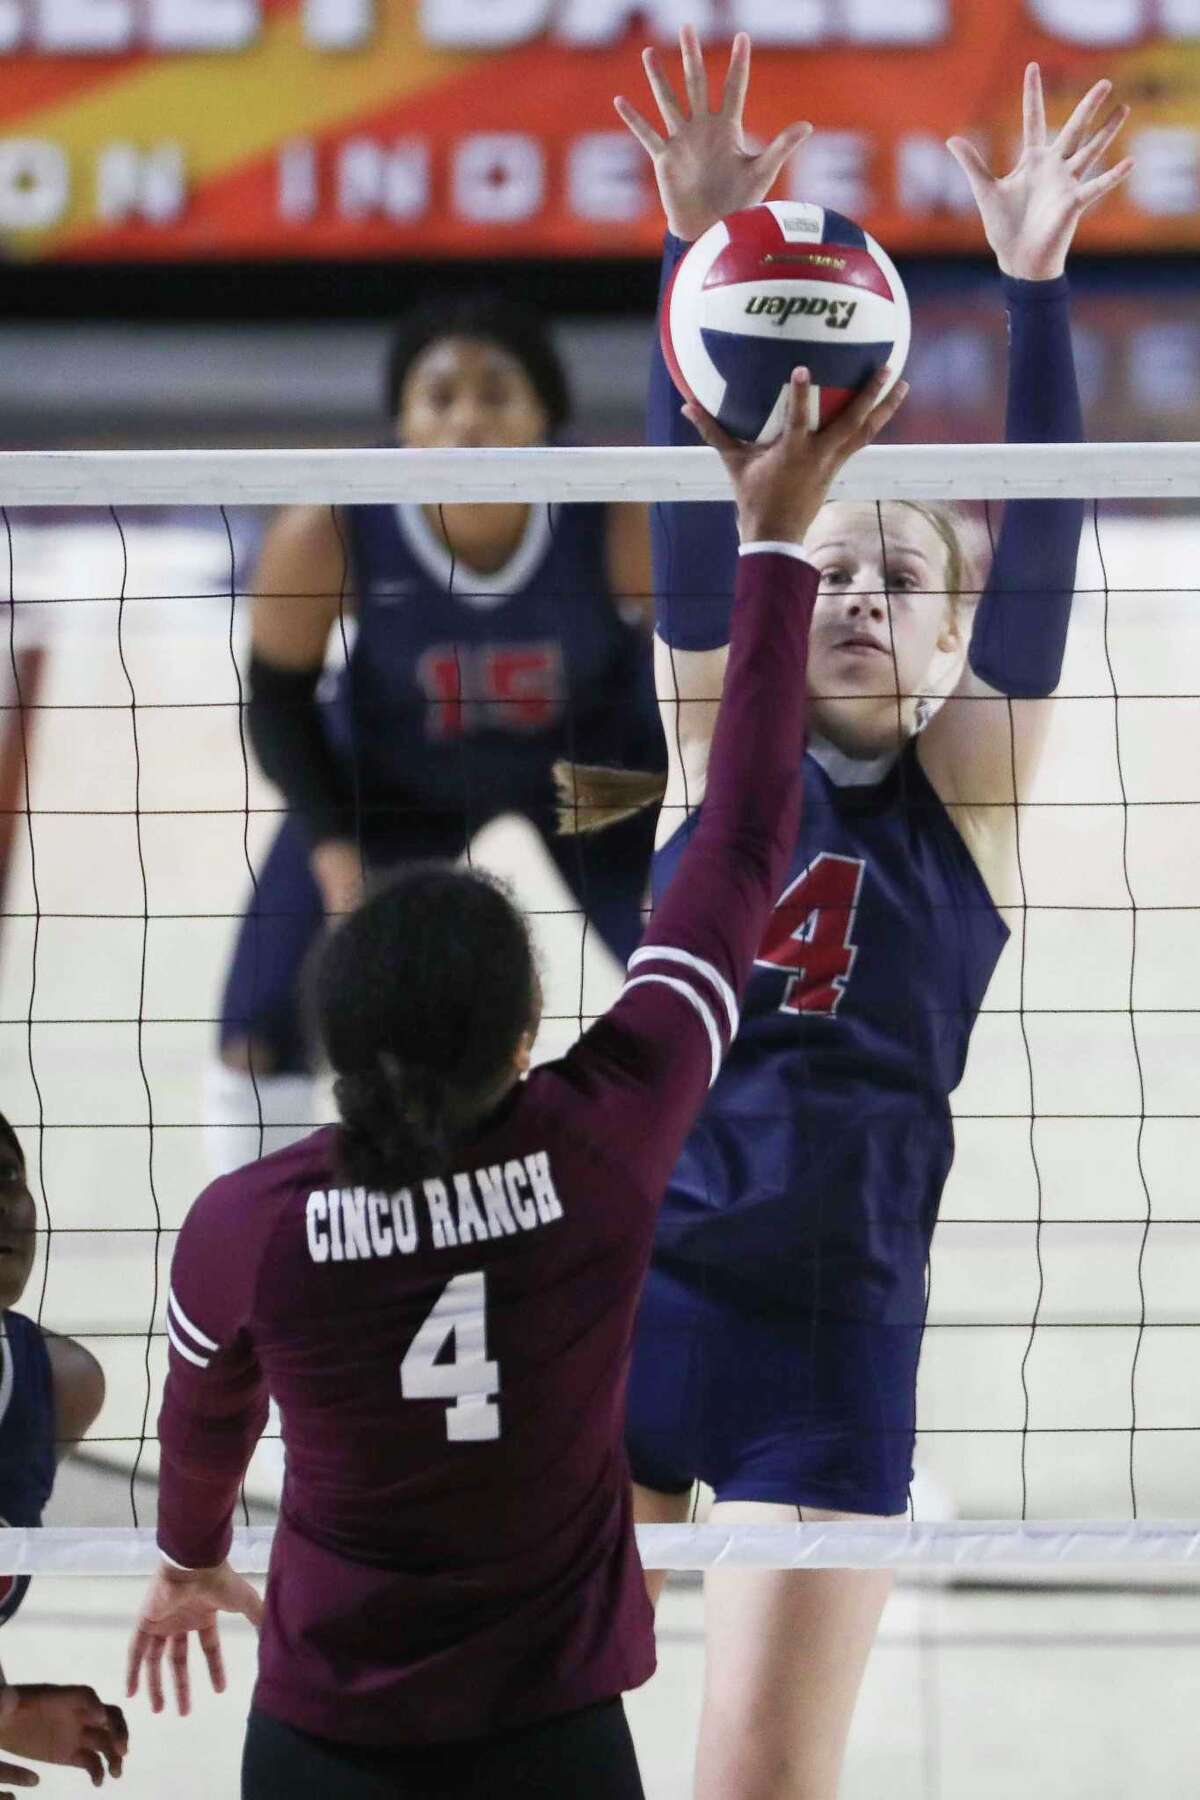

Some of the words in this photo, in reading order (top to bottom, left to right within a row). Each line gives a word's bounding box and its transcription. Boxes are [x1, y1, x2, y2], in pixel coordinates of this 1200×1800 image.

[744, 295, 857, 329] Baden
[416, 642, 562, 738] 15
[753, 851, 865, 1019] 4
[306, 1187, 417, 1262] CINCO
[422, 1151, 563, 1248] RANCH
[400, 1271, 500, 1441] 4
